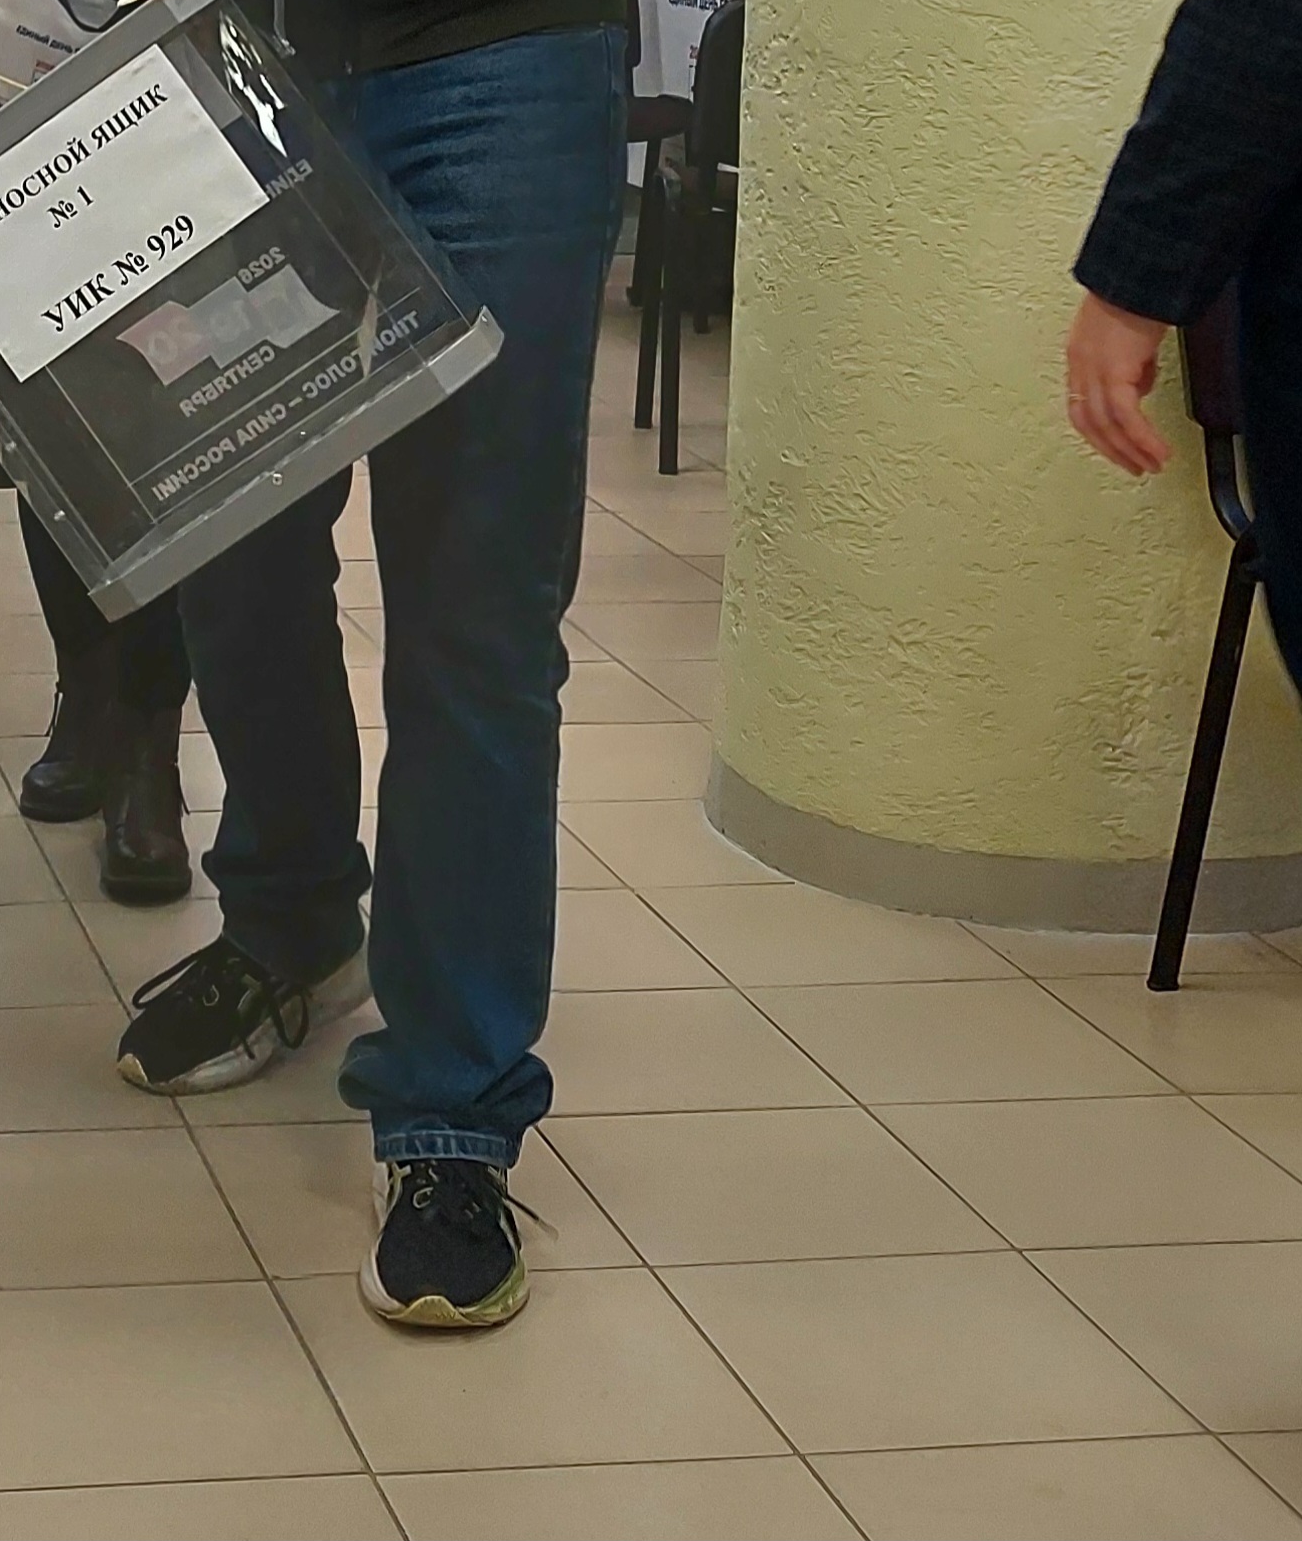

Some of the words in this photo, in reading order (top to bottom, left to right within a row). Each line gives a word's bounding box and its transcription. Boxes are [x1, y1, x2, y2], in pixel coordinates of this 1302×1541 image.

[89, 82, 170, 152] ЯЩИК
[46, 197, 80, 230] №
[77, 185, 95, 208] 1
[41, 271, 117, 334] УИК
[113, 249, 151, 287] №
[147, 213, 198, 262] 929
